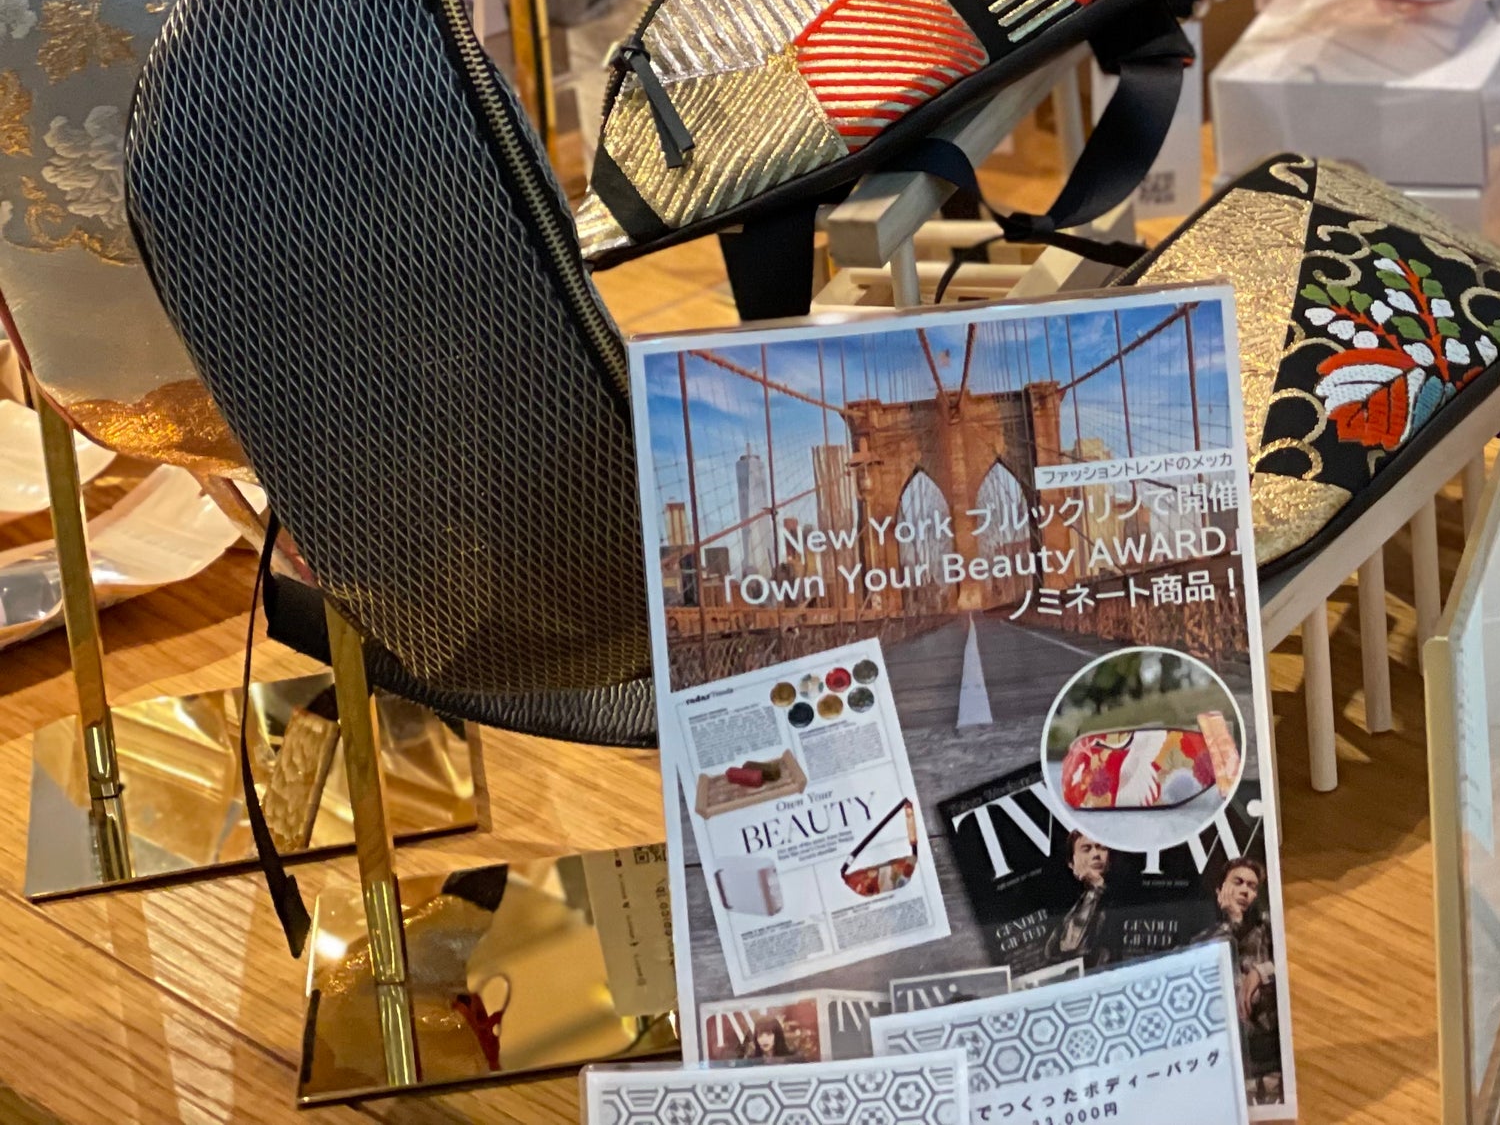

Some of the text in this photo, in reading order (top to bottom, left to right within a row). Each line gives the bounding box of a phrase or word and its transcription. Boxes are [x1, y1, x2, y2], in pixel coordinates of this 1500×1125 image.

[1042, 452, 1233, 485] ファッショントレンドのメッカ
[779, 479, 1239, 566] New York ブルックリンで開催
[837, 561, 931, 595] Your
[942, 545, 1076, 585] Beauty
[776, 788, 834, 814] Own Your
[741, 792, 875, 854] BEAUTY
[996, 908, 1048, 939] GENDER
[1123, 919, 1179, 934] GENDER
[967, 1050, 1220, 1123] でつくったボディーバッグ
